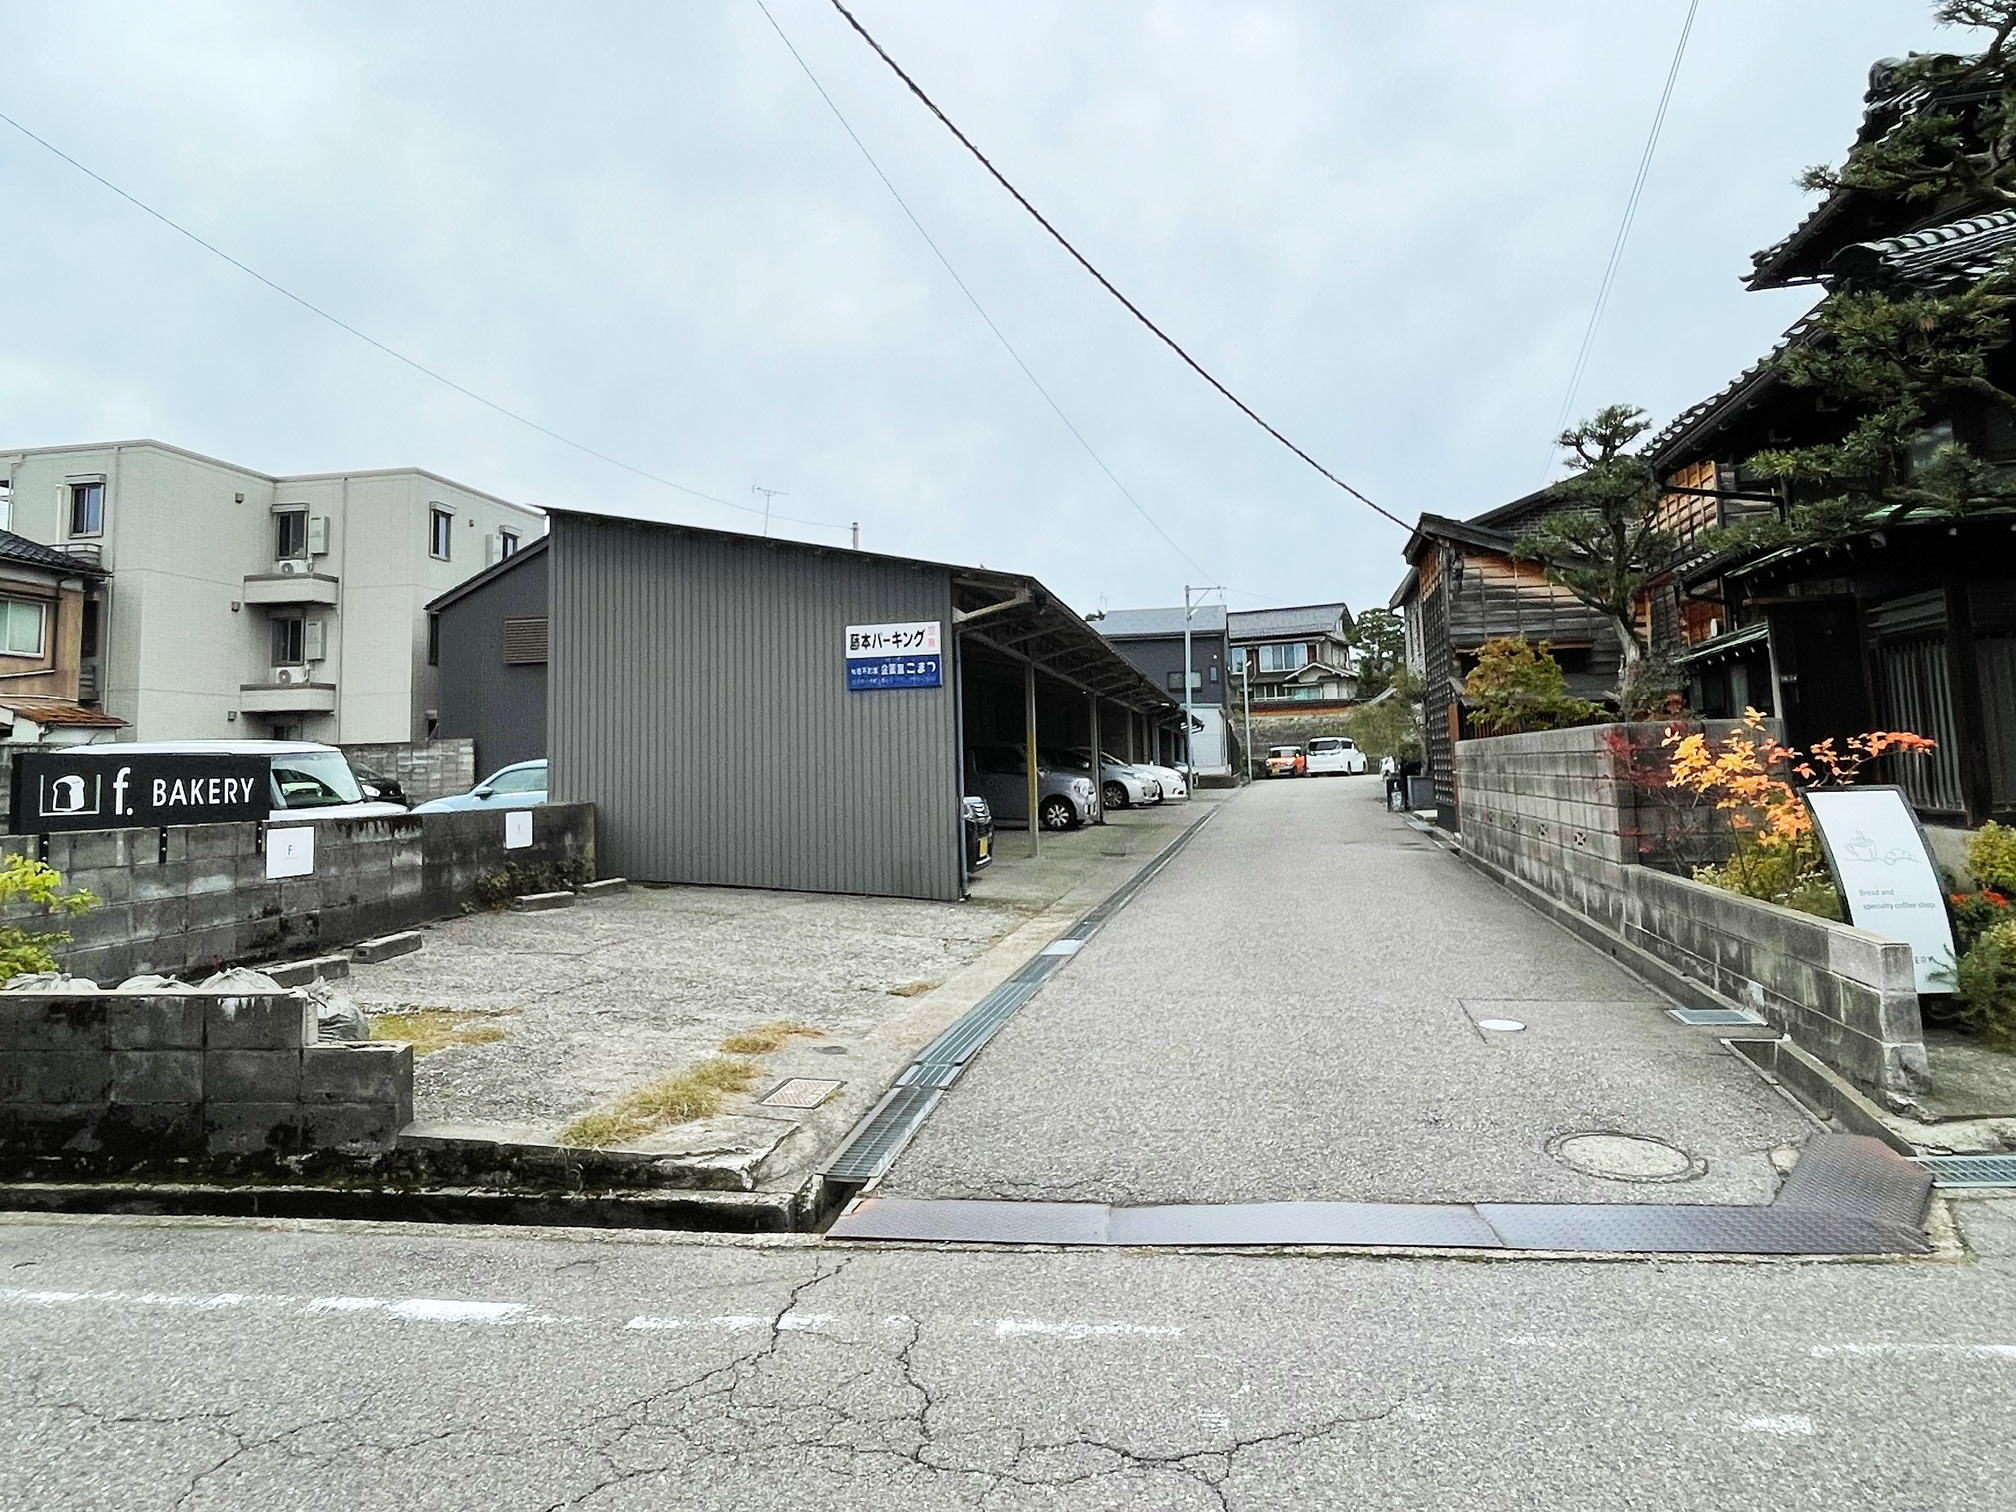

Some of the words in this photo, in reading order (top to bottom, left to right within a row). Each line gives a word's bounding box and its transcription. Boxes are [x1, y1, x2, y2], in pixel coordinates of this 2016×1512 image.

[152, 778, 254, 807] BAKERY
[1895, 901, 1917, 909] coffee
[1918, 901, 1935, 909] shop
